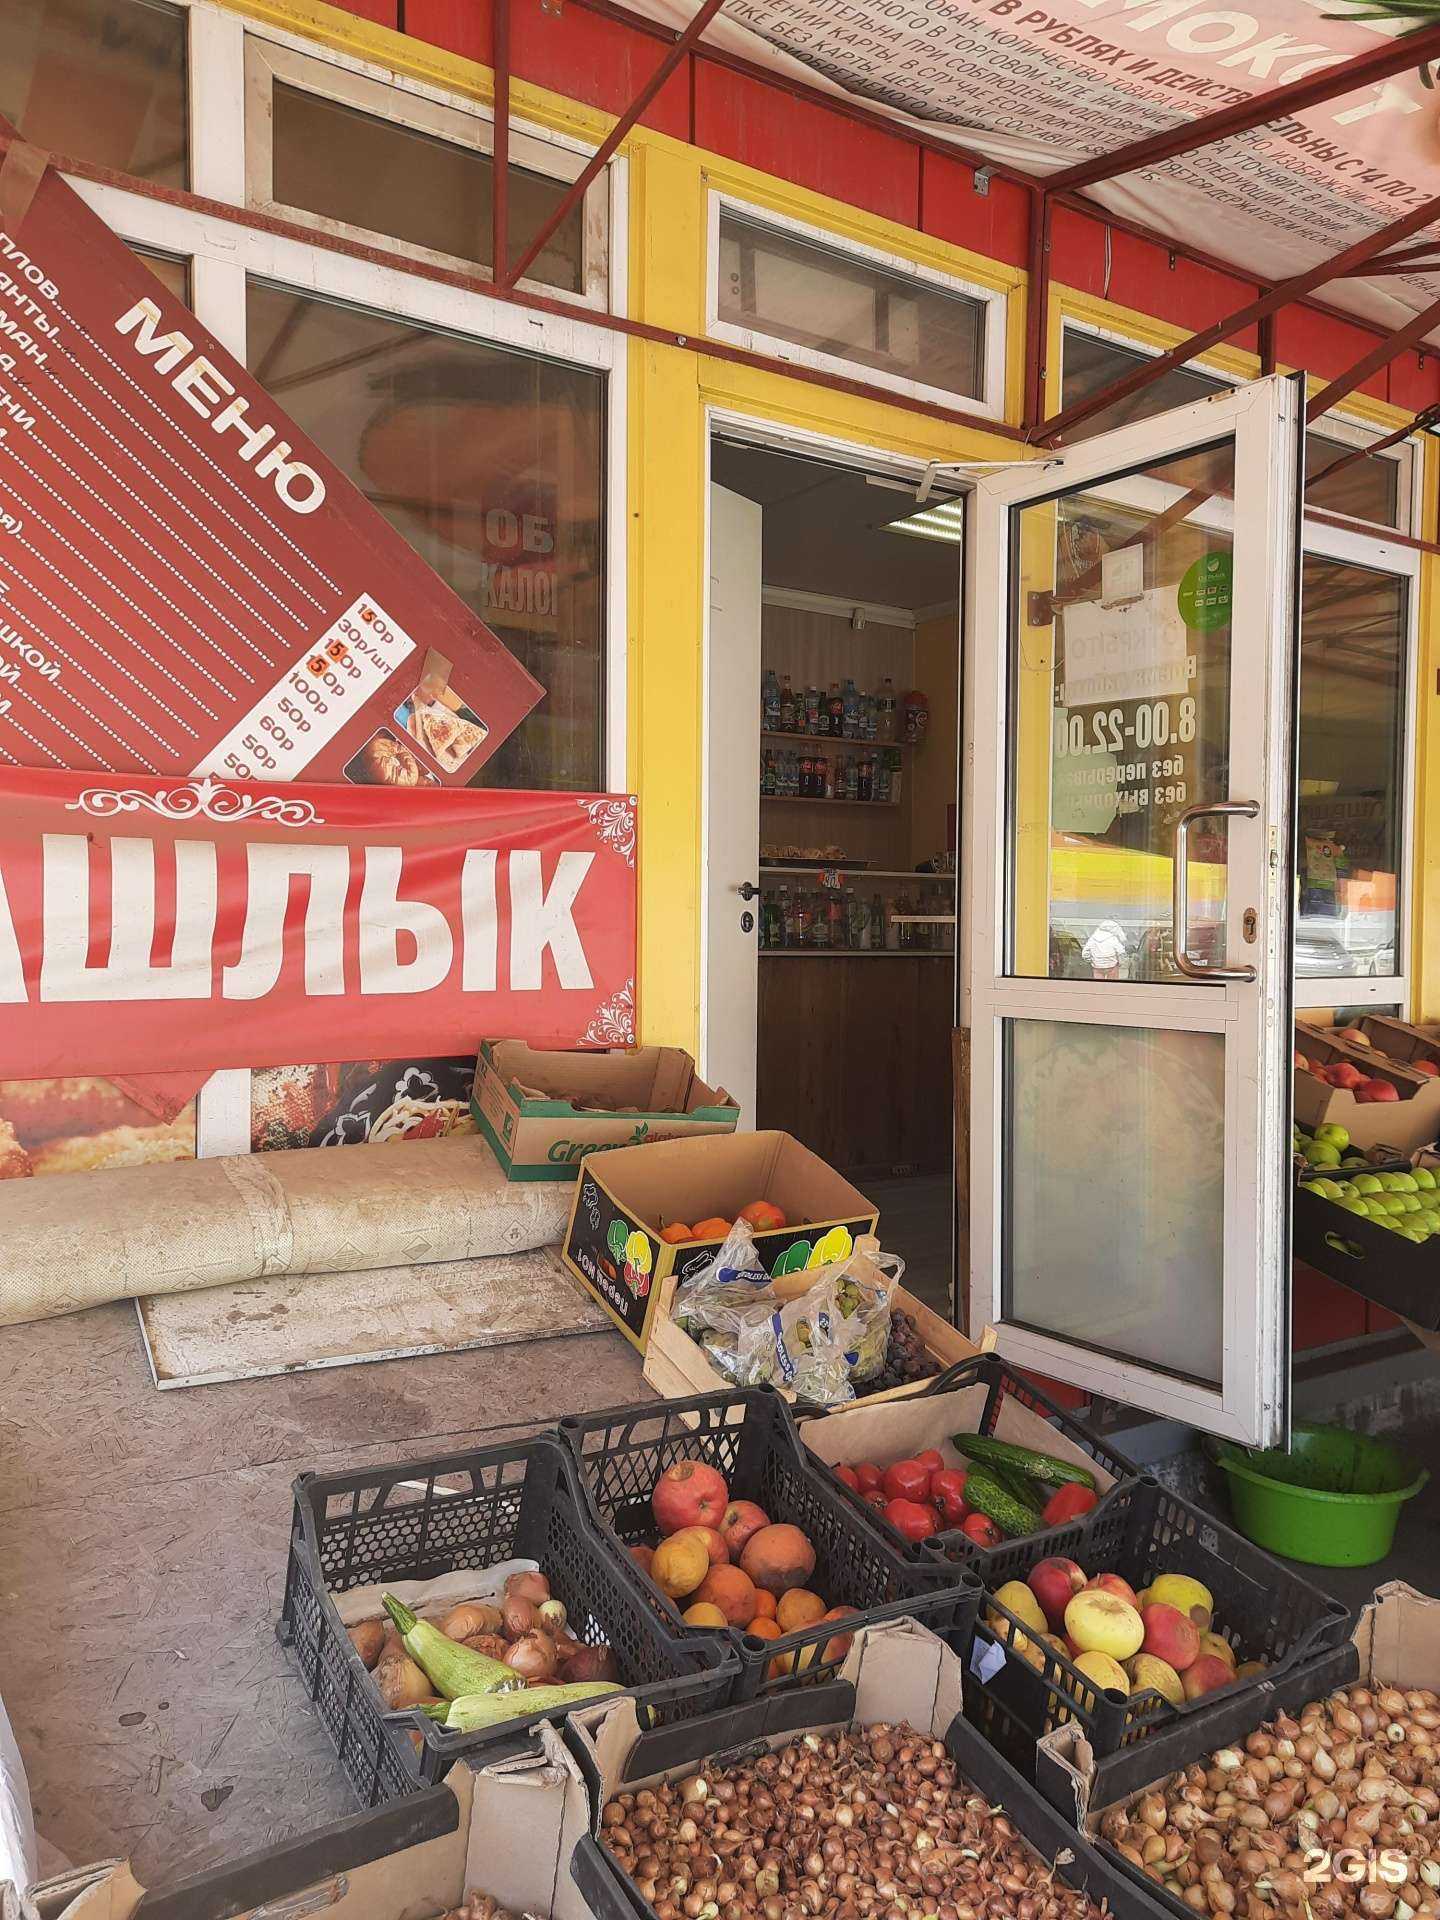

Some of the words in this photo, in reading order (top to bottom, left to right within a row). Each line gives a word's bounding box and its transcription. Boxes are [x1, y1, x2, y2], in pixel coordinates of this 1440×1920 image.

[763, 0, 831, 30] ЕНИИ
[828, 26, 899, 63] КАРТЫ,
[900, 60, 919, 69] В
[917, 67, 994, 99] СЛУЧАЕ
[988, 96, 1040, 116] ЕСЛИ
[1153, 158, 1215, 189] ЛЯЕТСЯ
[1203, 189, 1301, 230] ДЕРЖАТЕЛЕМ
[770, 21, 813, 43] БЕЗ
[810, 40, 881, 75] КАРТЫ,
[881, 72, 935, 95] ЦЕНА
[938, 95, 965, 107] ЗА
[995, 116, 1083, 147] СОСТАВИТ
[920, 0, 986, 32] ОВАН.
[984, 28, 1108, 82] КОЛИЧЕСТВО
[1104, 77, 1173, 105] ТОВАРА
[1268, 150, 1375, 206] ИЗОБРАЖЕНИЕ
[1369, 201, 1404, 219] ТОВА
[925, 25, 947, 38] В
[945, 33, 1048, 81] ТОРГОВОМ
[1041, 76, 1094, 99] ЗАЛЕ.
[1091, 95, 1176, 124] НАЛИЧИЕ
[1225, 150, 1312, 197] УТОЧНЯЙТЕ
[1301, 193, 1321, 202] В
[989, 0, 1022, 15] В
[1014, 10, 1136, 66] РУБЛЯХ
[1123, 58, 1158, 74] И
[1334, 158, 1364, 171] С
[1351, 167, 1388, 184] 14
[1374, 180, 1416, 198] ПО
[1403, 193, 1434, 207] 2
[902, 39, 950, 61] ПРИ
[945, 58, 1075, 109] СОБЛЮДЕНИИ
[1193, 157, 1289, 207] СЛЕДУЮЩИХ
[930, 107, 994, 131] ТОВАР
[0, 232, 59, 300] ПЛОВ
[0, 385, 36, 431] НИ
[115, 297, 325, 514] МЕНЮ
[338, 619, 393, 675] 30р/шт
[277, 697, 312, 733] 50р
[288, 671, 328, 715] 100р
[224, 753, 258, 781] 50
[242, 734, 277, 770] 50р
[259, 716, 295, 751] 60р
[0, 833, 596, 1003] ШЛЫК
